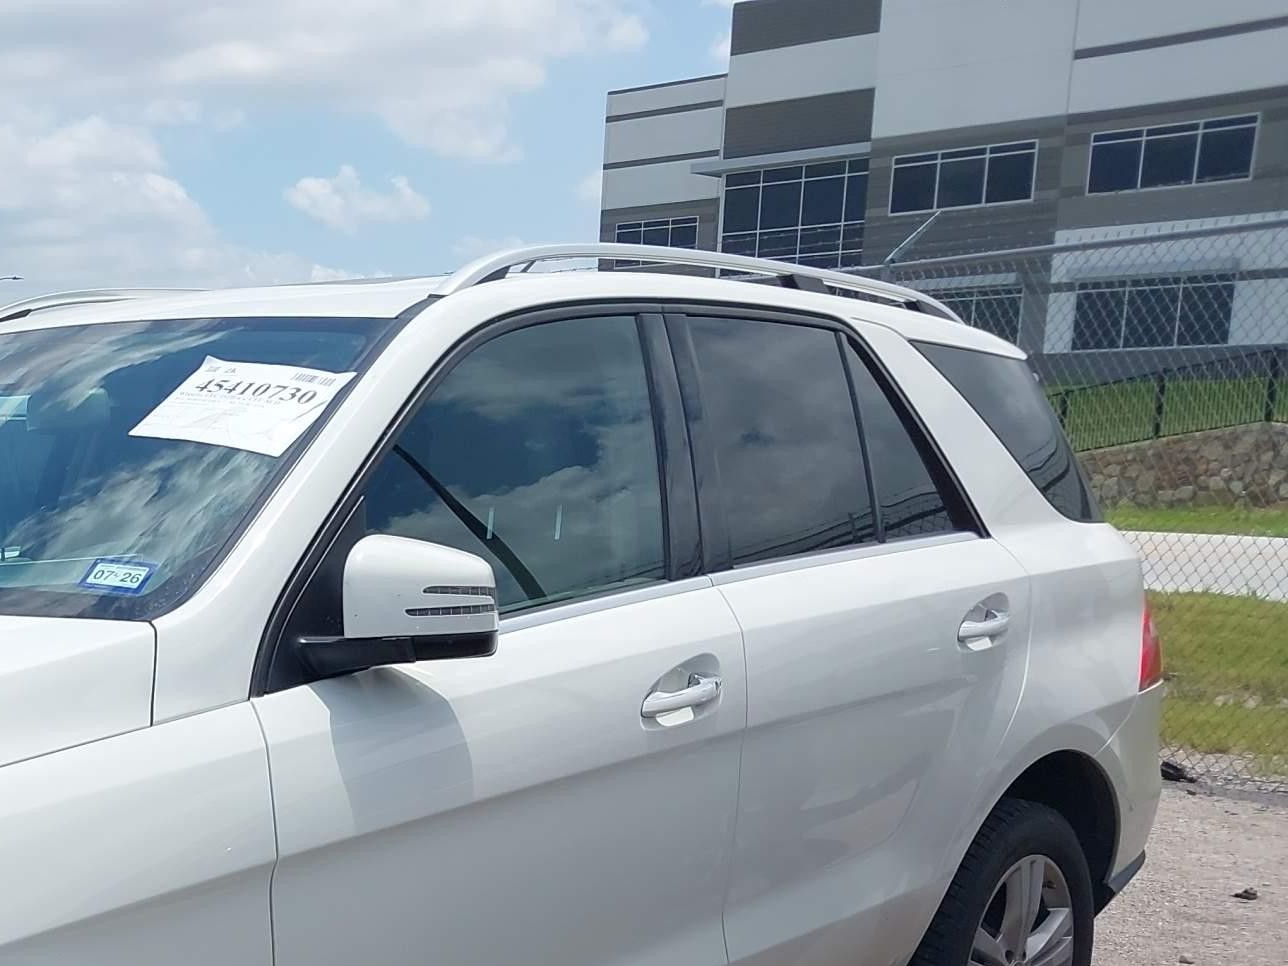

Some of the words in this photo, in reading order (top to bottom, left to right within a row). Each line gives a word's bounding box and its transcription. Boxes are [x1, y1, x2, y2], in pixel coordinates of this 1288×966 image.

[195, 378, 318, 405] 45410730
[93, 569, 115, 581] 07
[119, 571, 142, 584] 26
